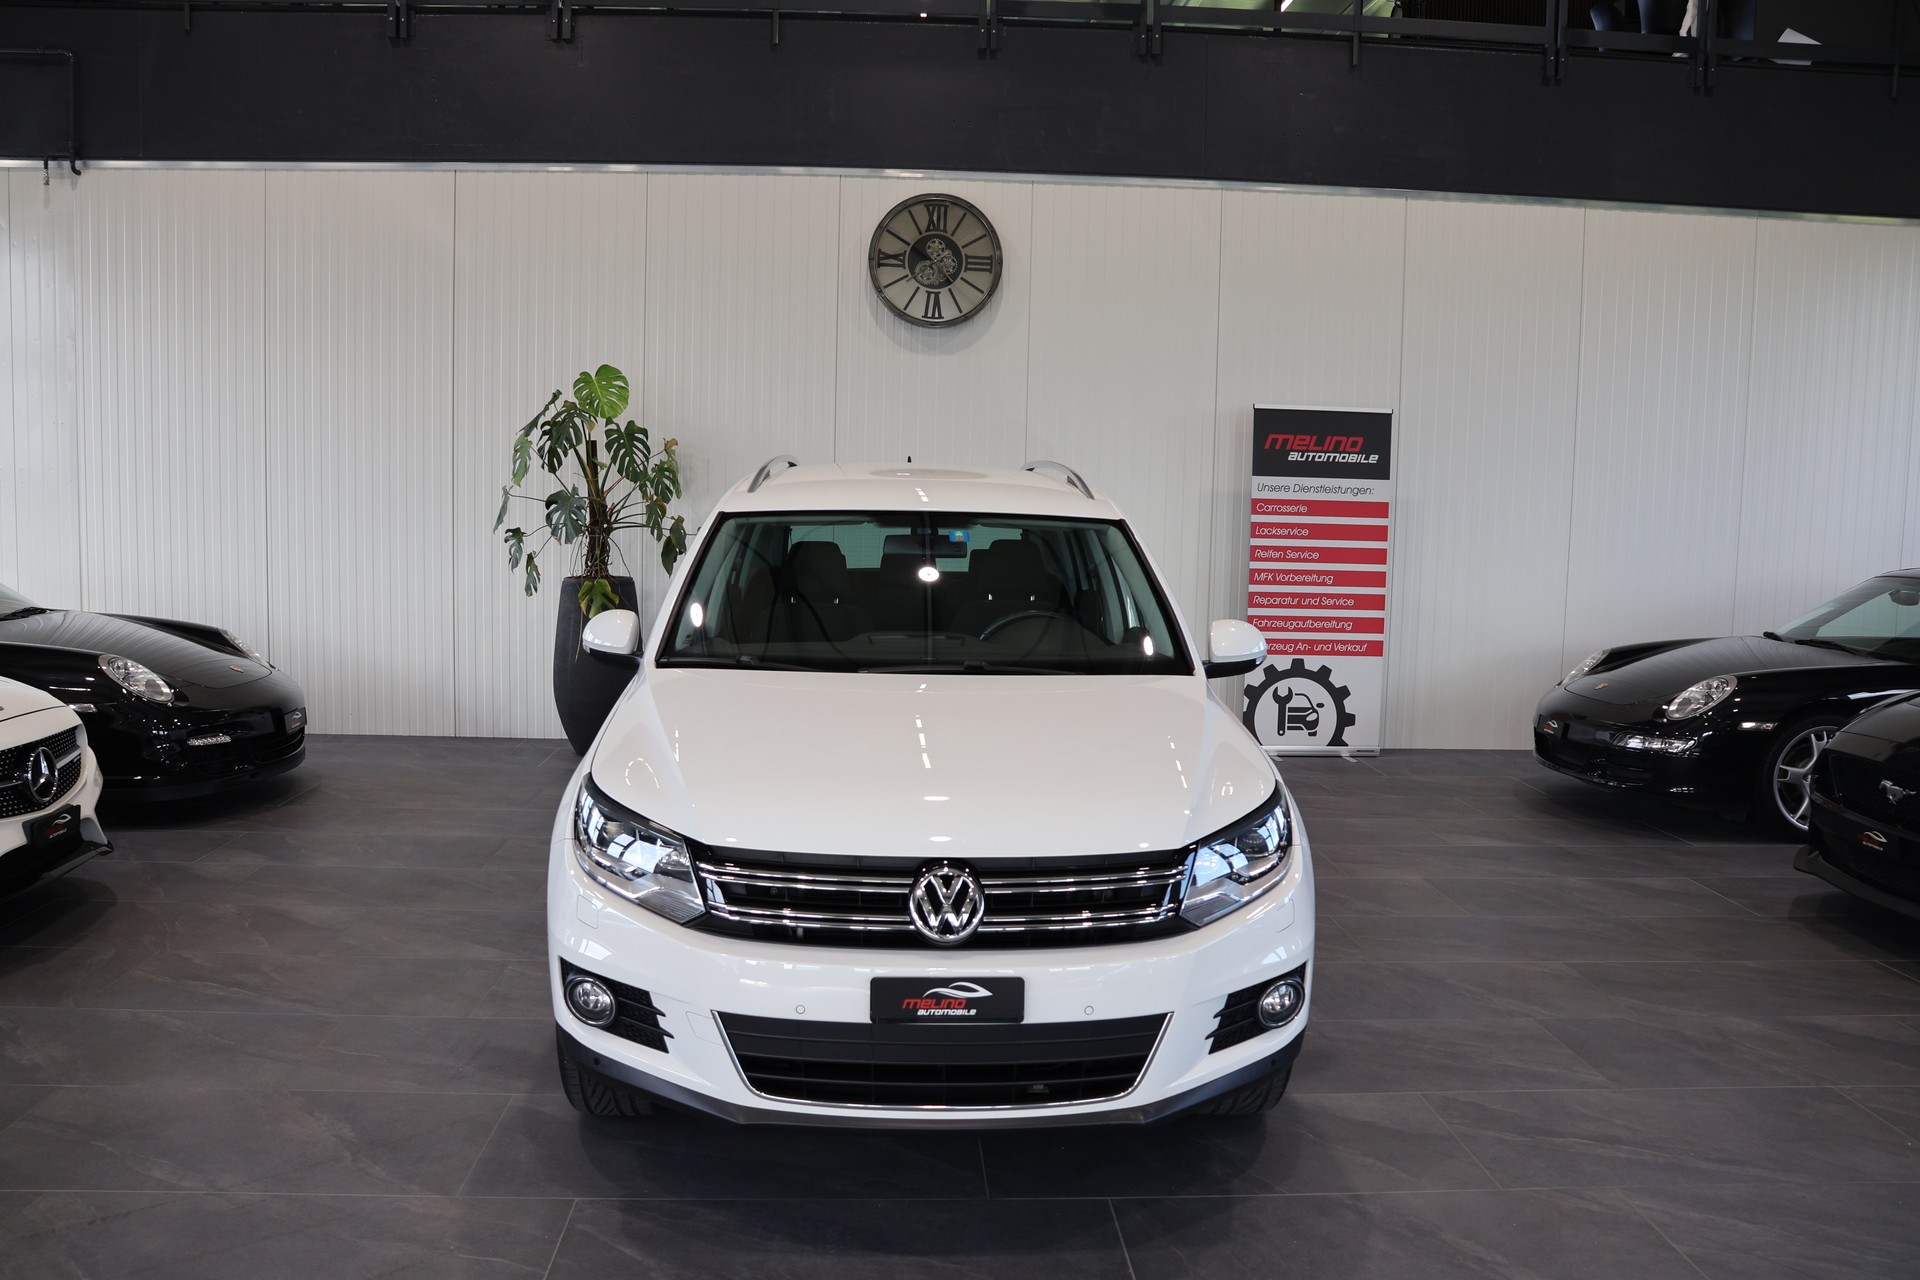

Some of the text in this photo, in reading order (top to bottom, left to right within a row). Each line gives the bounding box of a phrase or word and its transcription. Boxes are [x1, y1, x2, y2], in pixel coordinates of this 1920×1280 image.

[1257, 482, 1375, 497] Unsere Dienstleistungen:
[1256, 503, 1308, 513] Carrosserie
[1255, 526, 1309, 536] Lackservice
[1254, 549, 1319, 560] Reifen Service
[1253, 573, 1334, 585] MFK Vorbereitung
[1253, 595, 1355, 607] Reparatur und Service
[1252, 618, 1353, 630] Fahrzeugaufbereitung
[1266, 642, 1368, 653] rzeug An- und Verkauf
